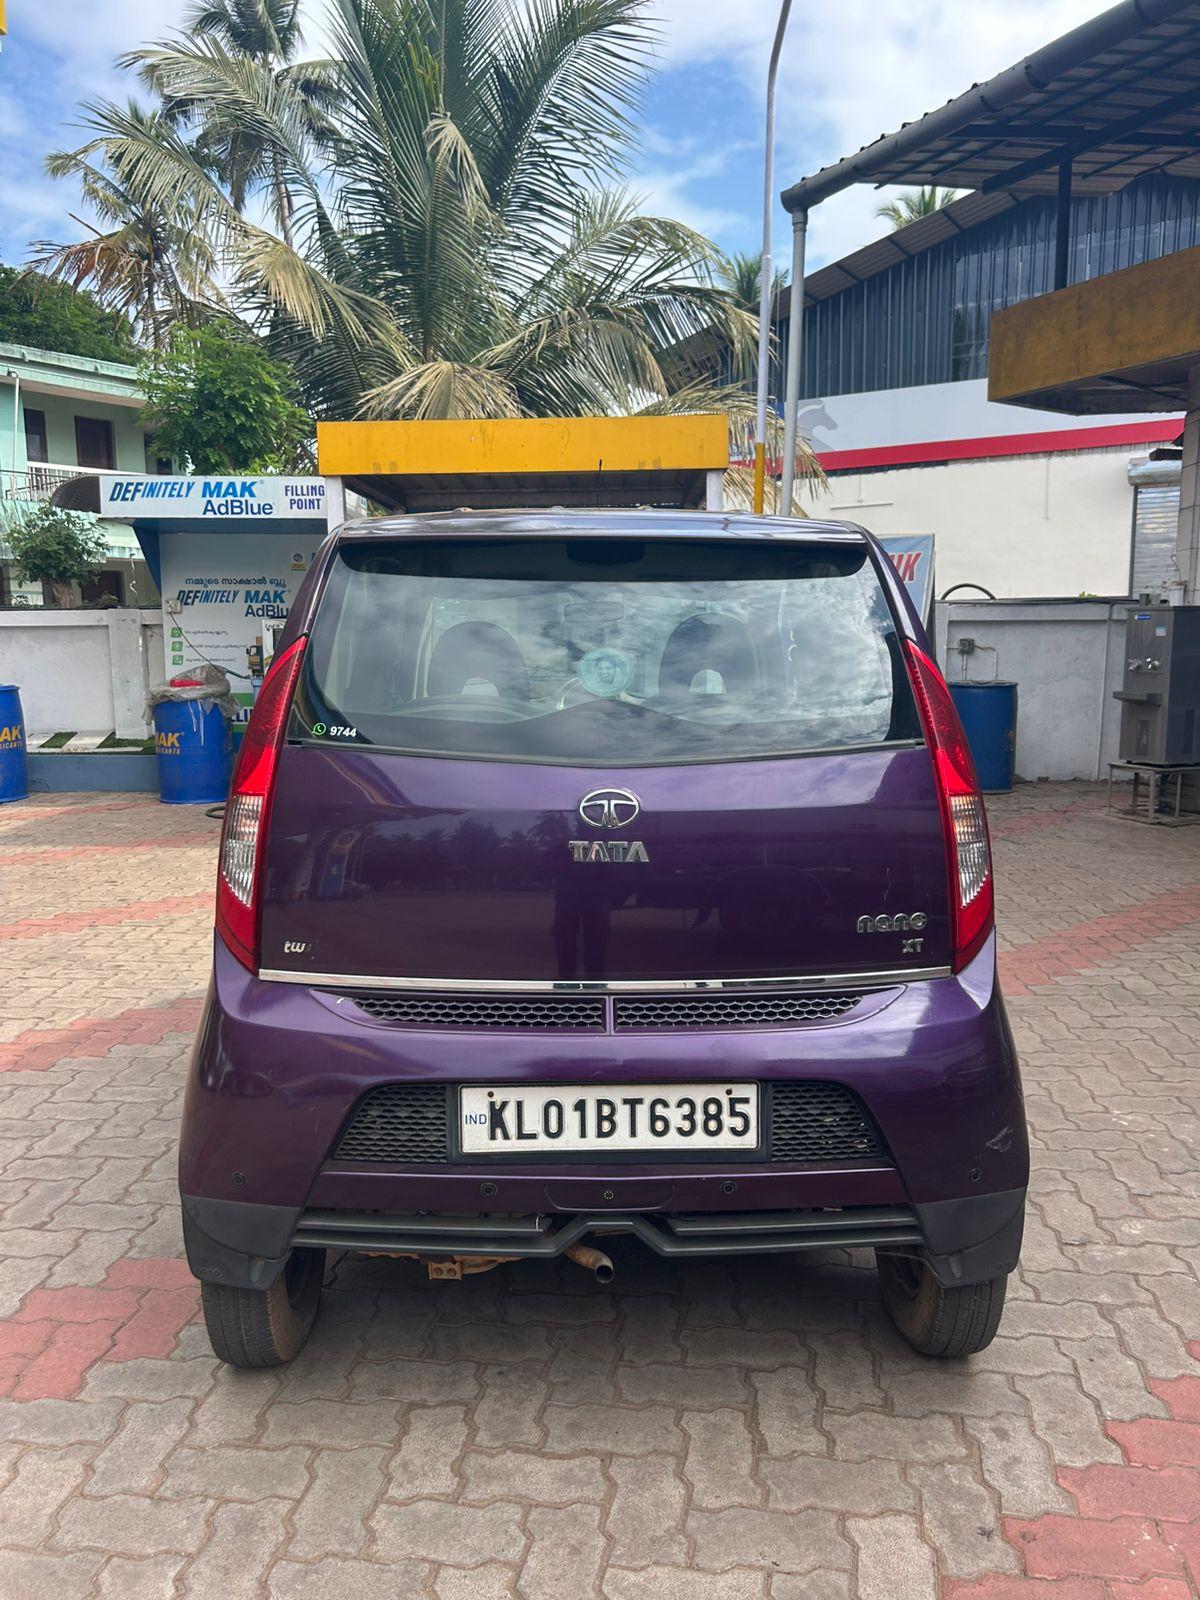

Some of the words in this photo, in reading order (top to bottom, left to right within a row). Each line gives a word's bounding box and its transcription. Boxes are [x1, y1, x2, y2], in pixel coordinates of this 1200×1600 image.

[109, 481, 195, 502] DEFINITELY
[201, 481, 257, 498] MAK
[285, 485, 325, 497] FILLING
[202, 500, 273, 516] AdBlue
[290, 498, 321, 510] POINT
[177, 590, 239, 606] DEFINITELY
[244, 590, 286, 604] MAK
[245, 604, 289, 618] AdBlu
[0, 727, 22, 742] AK
[155, 732, 180, 747] AK
[330, 726, 357, 737] 9744
[569, 841, 650, 863] TATA
[857, 911, 927, 934] nano
[902, 938, 924, 954] XT
[465, 1114, 487, 1125] IND
[488, 1097, 750, 1140] KL01BT6385
